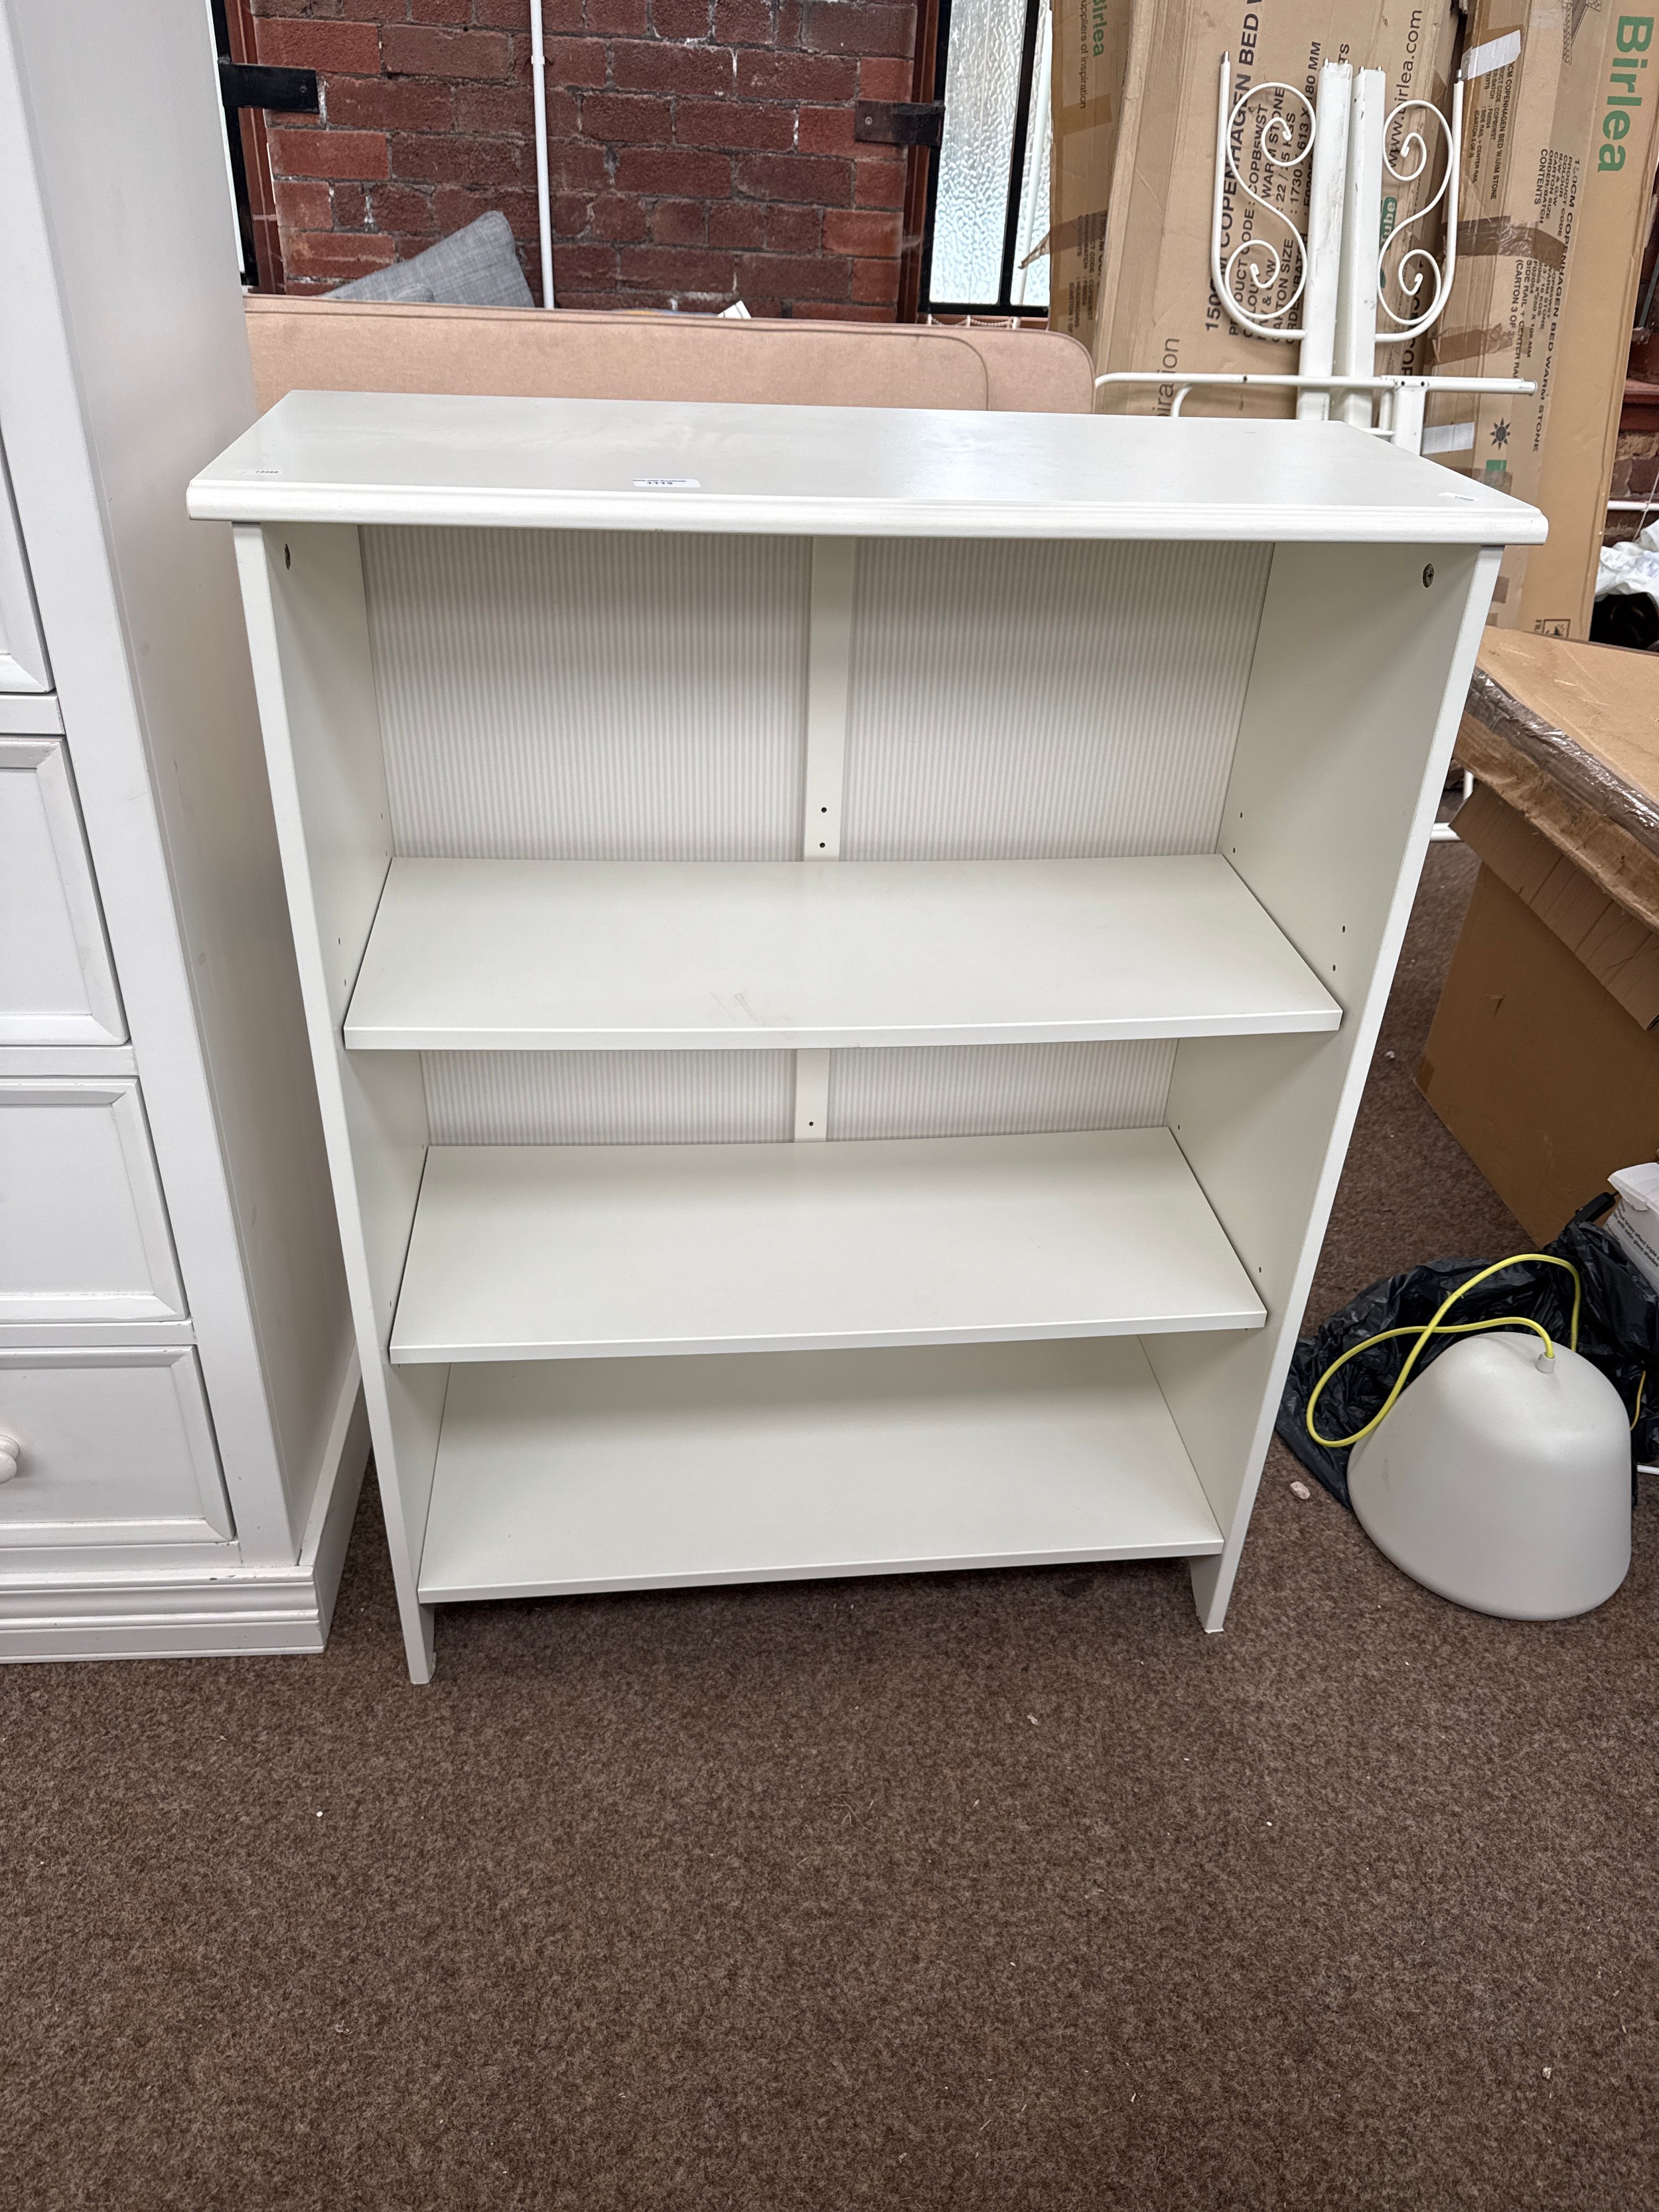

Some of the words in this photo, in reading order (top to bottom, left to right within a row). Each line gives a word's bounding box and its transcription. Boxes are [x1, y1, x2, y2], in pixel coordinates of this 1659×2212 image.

[1079, 0, 1088, 41] uppliers
[1239, 13, 1259, 66] BED
[1080, 43, 1088, 54] of
[1079, 56, 1088, 109] inspiration
[1597, 15, 1654, 173] Birlea
[1269, 87, 1285, 143] STONE
[1500, 79, 1512, 132] COPENHAGEN
[1281, 238, 1293, 273] SIZE
[1290, 169, 1303, 204] 1730
[1297, 123, 1309, 151] 613
[1308, 41, 1321, 70] MM
[1494, 150, 1502, 173] WARM
[1534, 149, 1548, 204] CONTENTS
[1550, 151, 1559, 195] CARTON
[1559, 154, 1567, 198] COLOUR
[1276, 184, 1287, 202] 22
[1490, 175, 1499, 200] STONE
[1539, 150, 1553, 224] ORDER/BATCH
[1562, 156, 1573, 206] PRODUCT
[1512, 259, 1524, 305] (CARTON
[1510, 315, 1518, 329] OF
[1515, 320, 1525, 360] CENTER
[1548, 322, 1557, 352] BED
[1540, 355, 1552, 400] WARM
[1532, 404, 1544, 453] STONE
